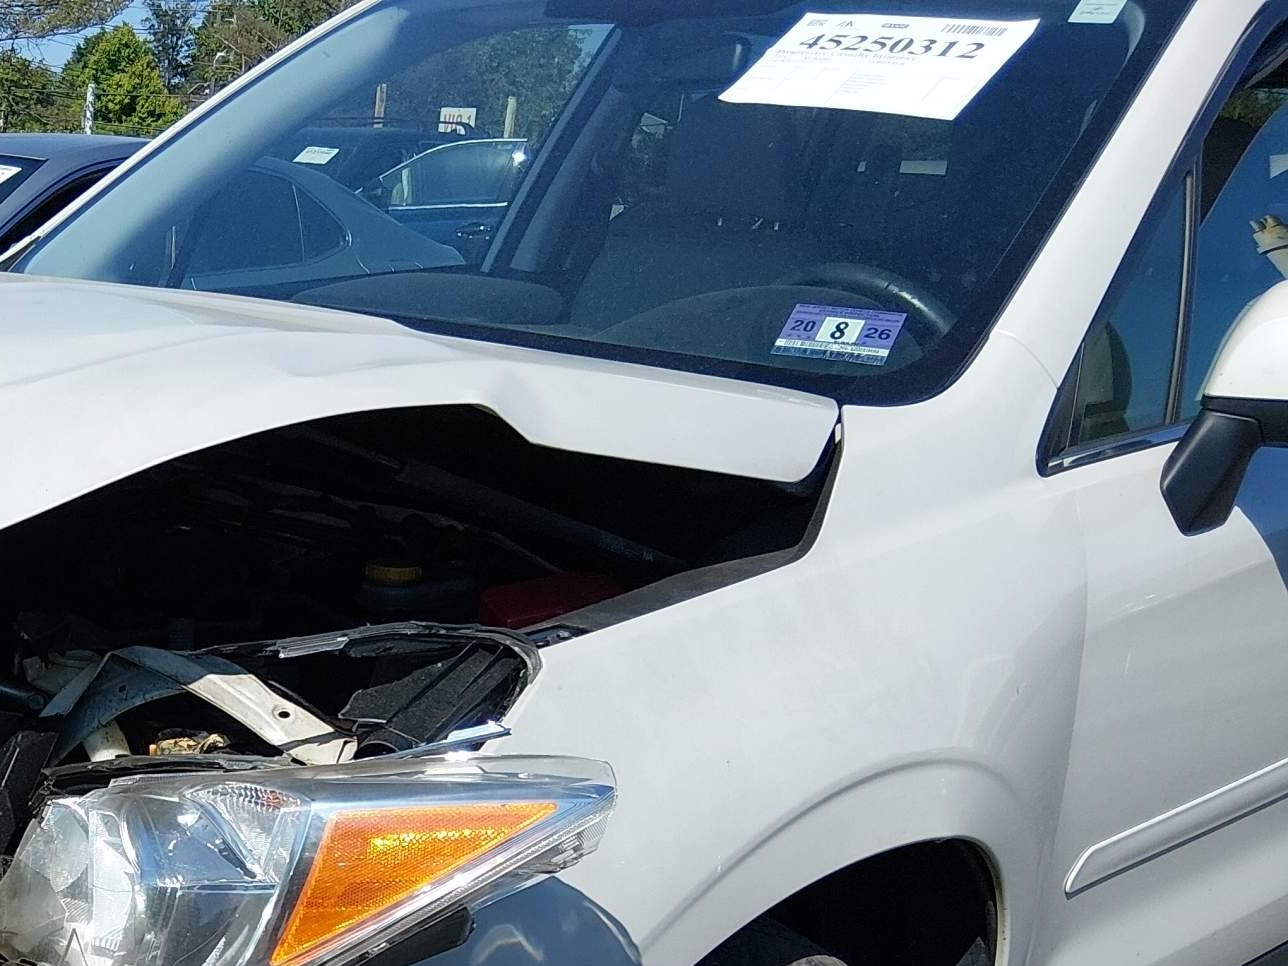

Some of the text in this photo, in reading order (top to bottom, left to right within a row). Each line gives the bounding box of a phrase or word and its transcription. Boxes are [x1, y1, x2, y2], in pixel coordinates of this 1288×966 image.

[800, 33, 985, 58] 45250312
[791, 319, 892, 340] 20 8 26
